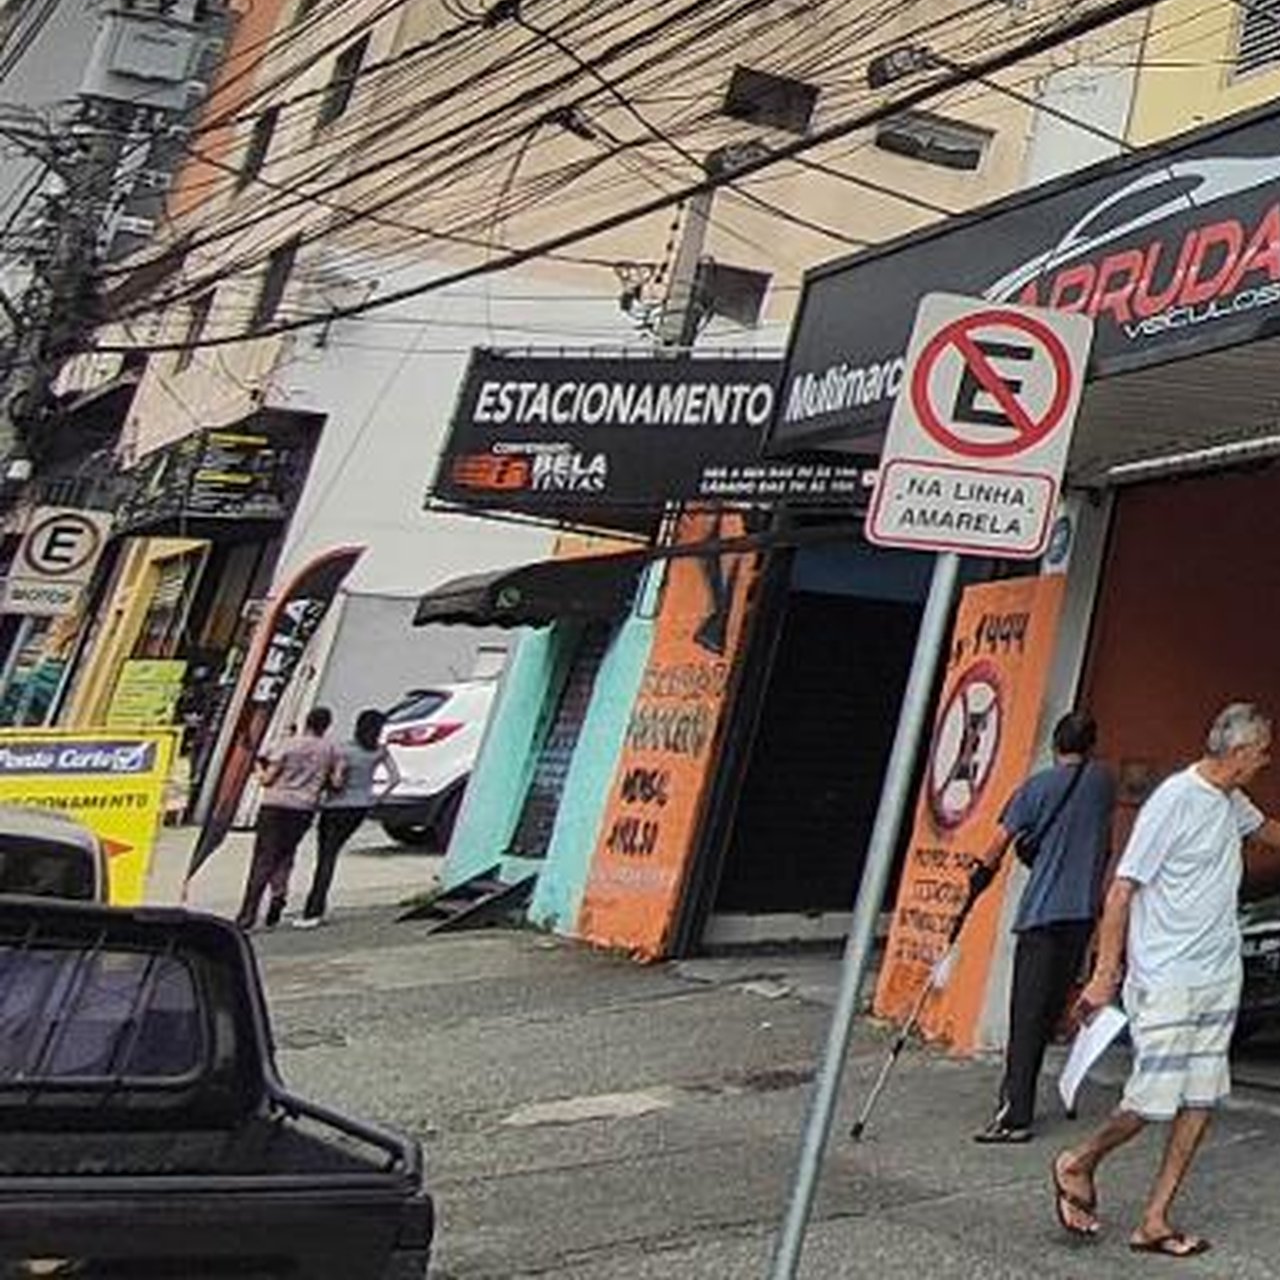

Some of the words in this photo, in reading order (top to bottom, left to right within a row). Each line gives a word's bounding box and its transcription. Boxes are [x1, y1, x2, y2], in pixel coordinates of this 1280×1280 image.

[472, 381, 775, 426] ESTACIONAMENTO
[785, 357, 905, 423] Multimarc
[532, 453, 606, 475] BELA
[906, 477, 942, 498] NA
[953, 482, 1025, 507] LINHA
[899, 507, 1022, 535] AMARELA
[42, 526, 84, 563] E
